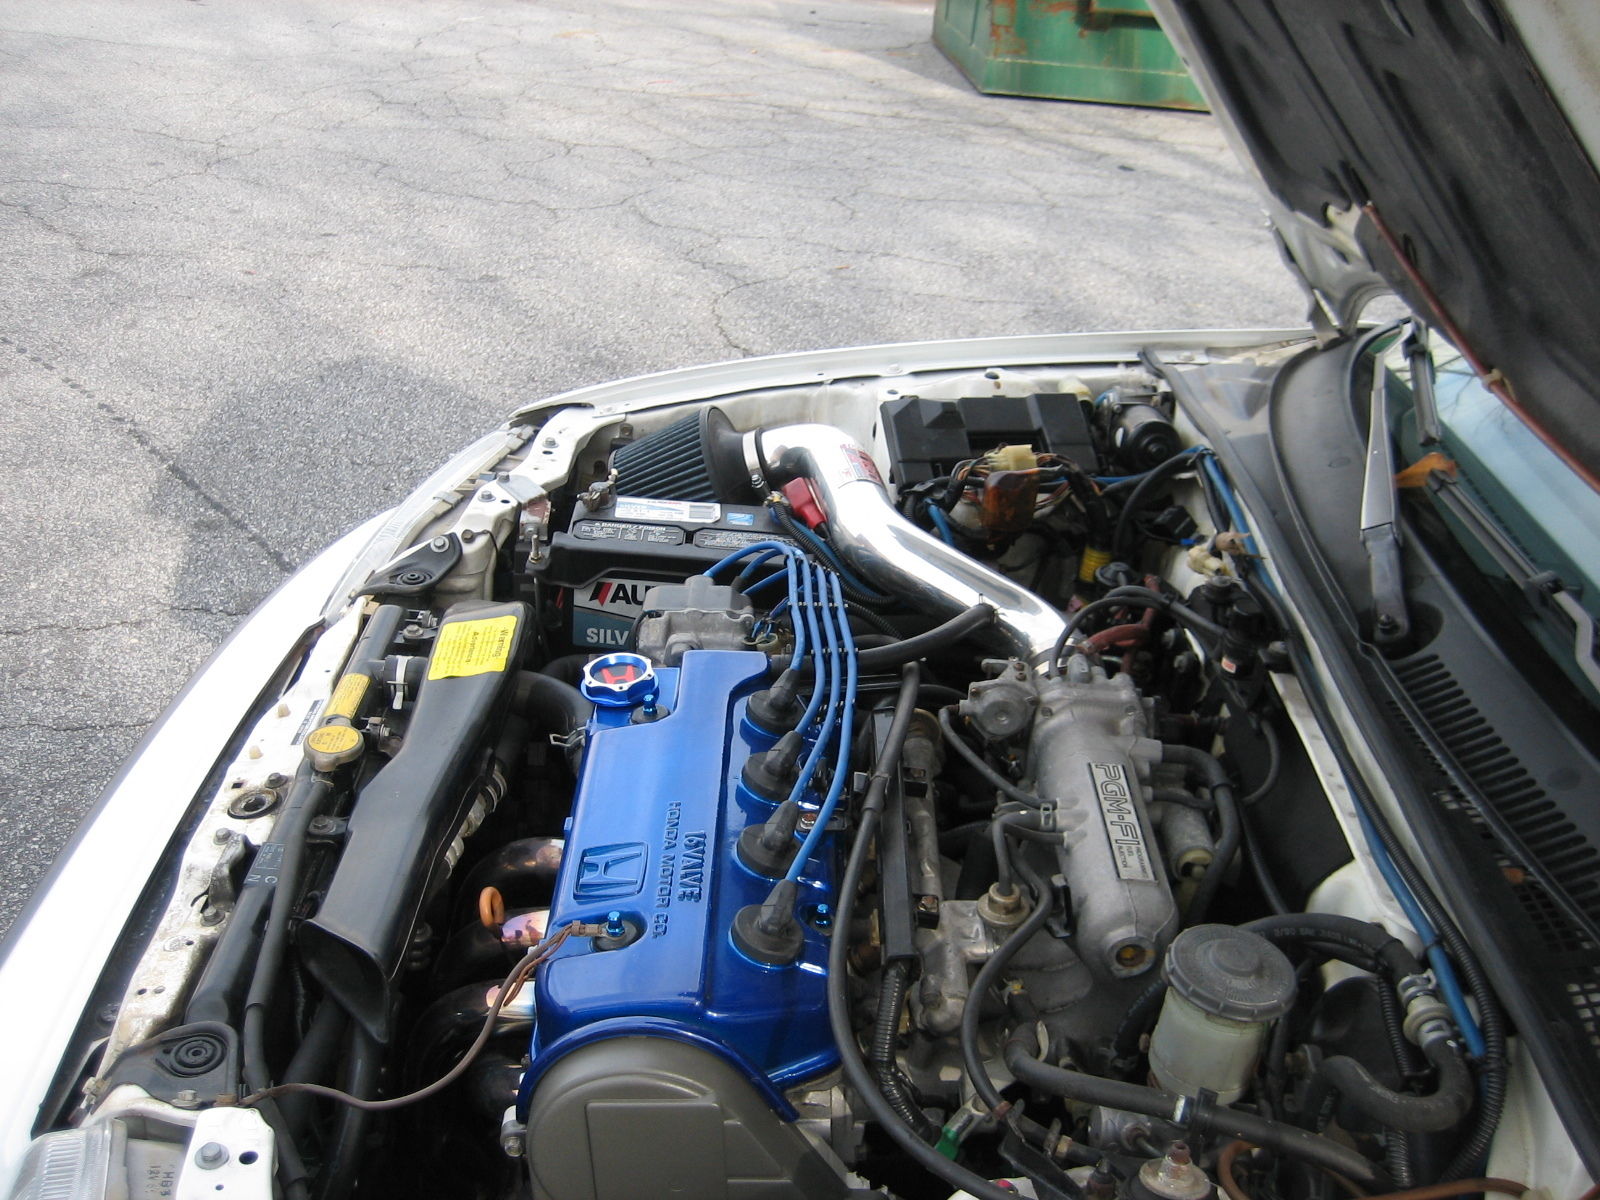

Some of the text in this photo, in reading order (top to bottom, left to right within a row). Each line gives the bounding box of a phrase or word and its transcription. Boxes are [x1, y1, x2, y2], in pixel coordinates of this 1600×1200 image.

[610, 583, 657, 606] AU
[586, 628, 630, 646] SILV
[664, 801, 681, 850] HONDA
[1095, 763, 1140, 845] PGM-FI
[656, 854, 676, 908] MOTOR
